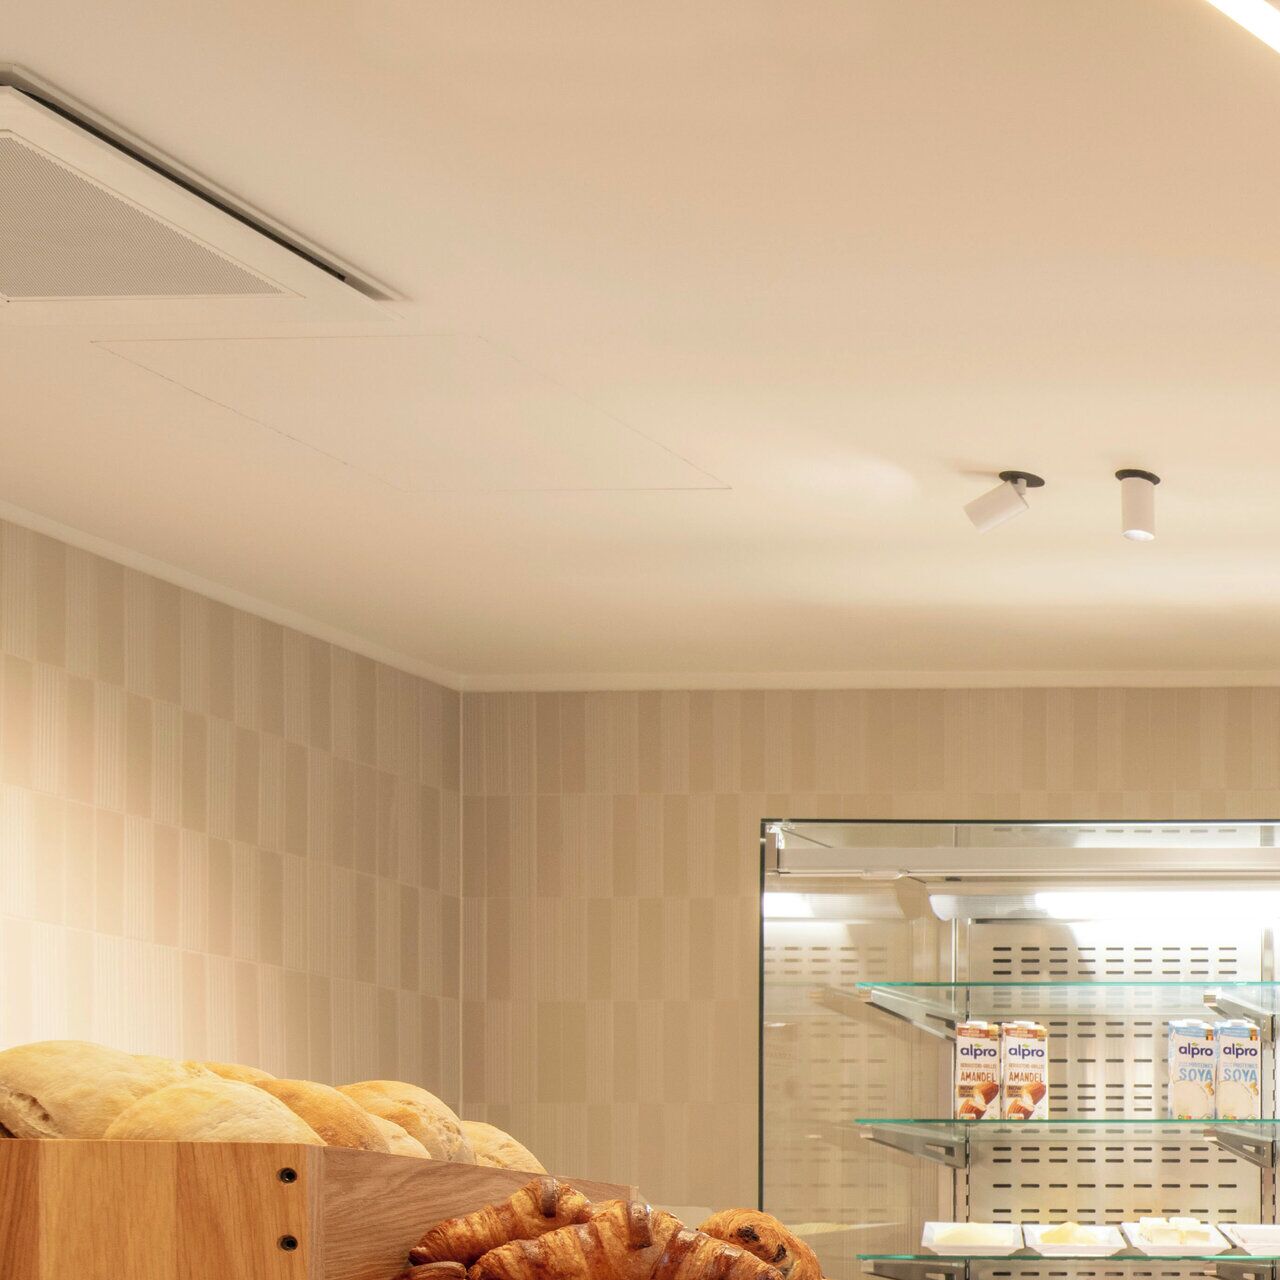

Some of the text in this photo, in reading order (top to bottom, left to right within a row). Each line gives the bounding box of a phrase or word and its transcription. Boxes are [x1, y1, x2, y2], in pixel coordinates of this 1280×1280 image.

[960, 1044, 997, 1059] alpro
[1008, 1044, 1045, 1059] alpro
[1178, 1042, 1214, 1058] alpro
[1223, 1043, 1258, 1059] alpro
[960, 1071, 996, 1082] AMANDEL
[1008, 1071, 1044, 1082] AMANDEL
[1178, 1068, 1213, 1082] SOYA
[1223, 1068, 1258, 1082] SOYA
